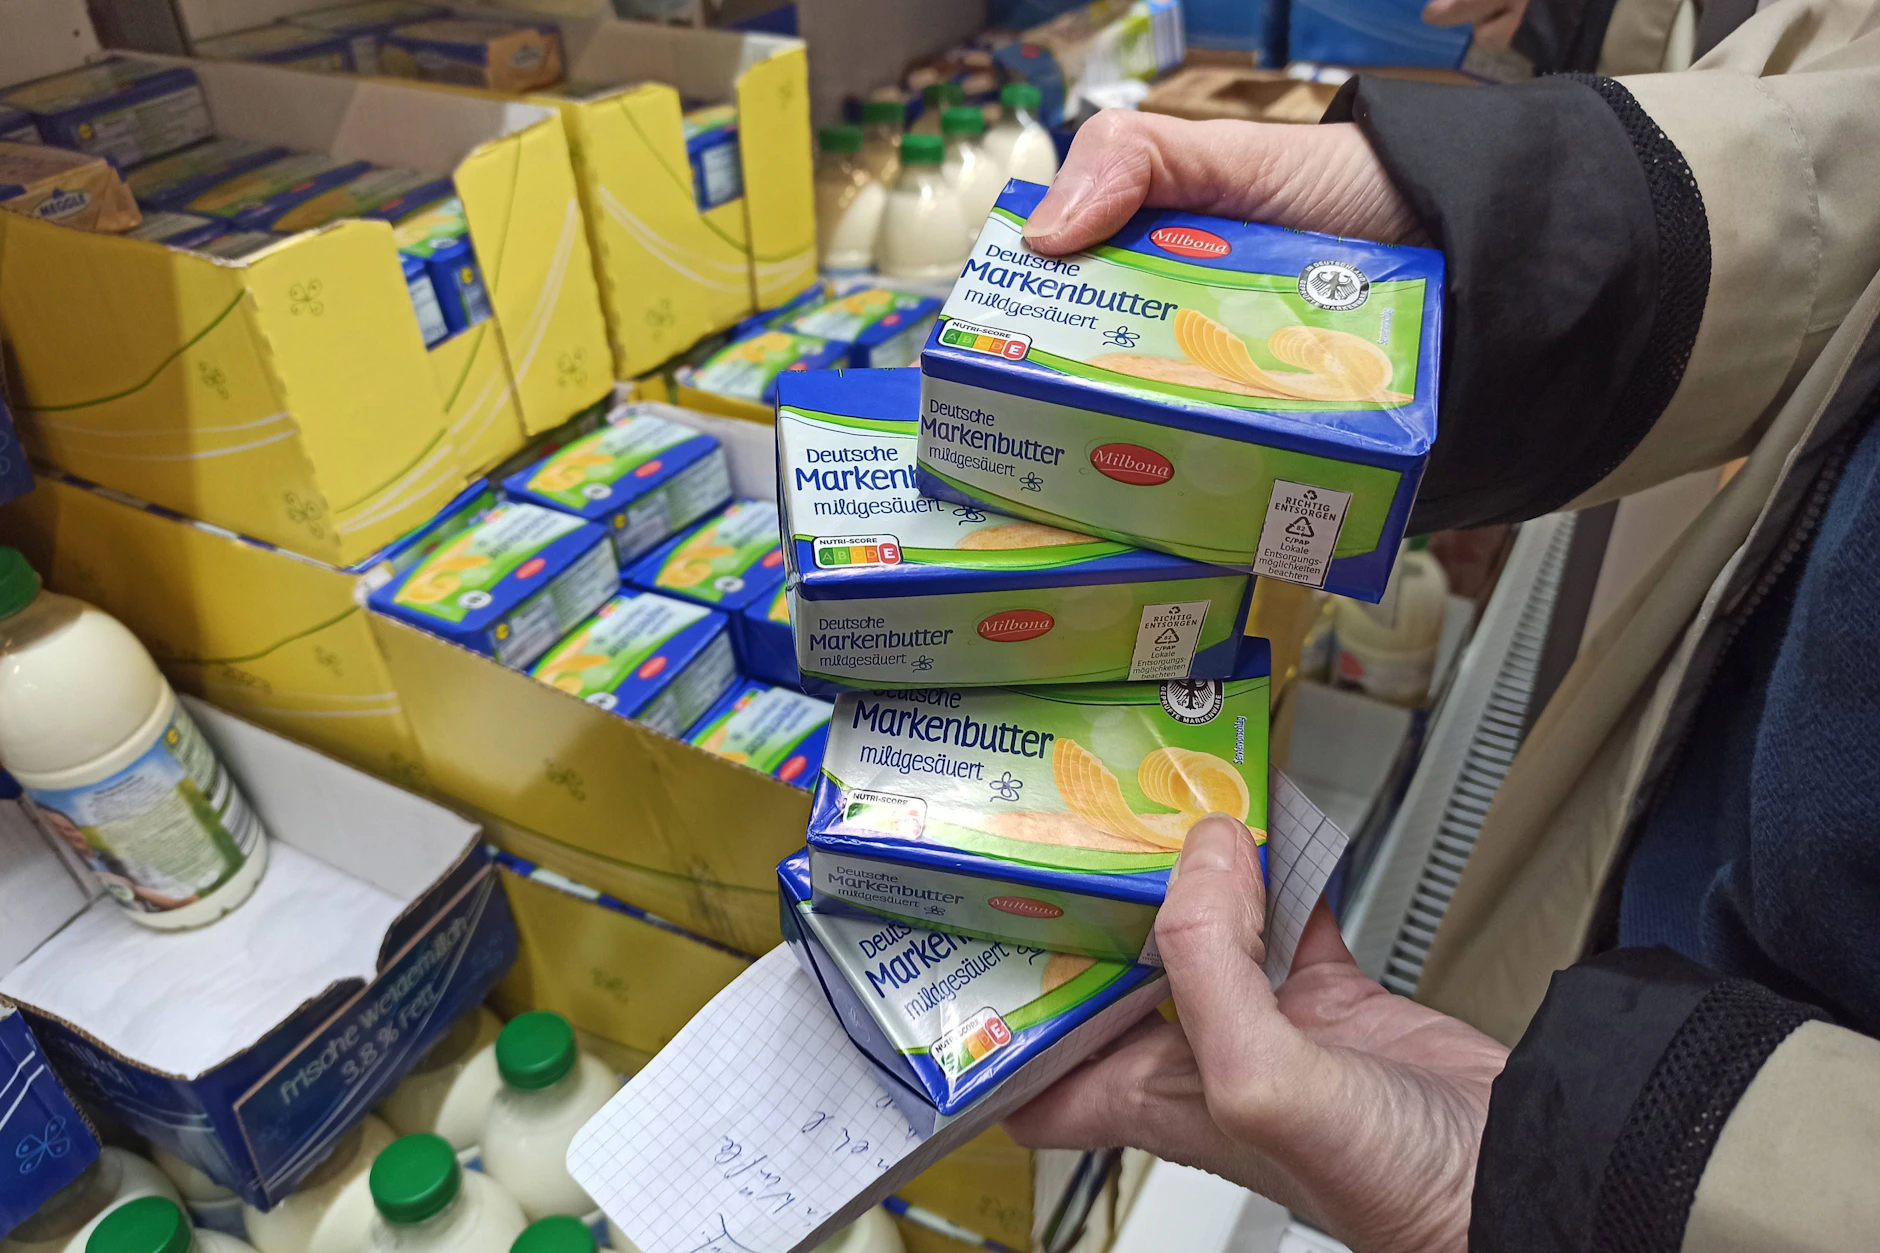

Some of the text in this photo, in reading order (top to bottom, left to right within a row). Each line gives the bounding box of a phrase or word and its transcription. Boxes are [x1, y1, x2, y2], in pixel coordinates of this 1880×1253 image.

[1150, 229, 1228, 254] Milbona
[985, 244, 1081, 277] Deutsche
[959, 258, 1179, 322] Markenbutter
[963, 288, 1100, 330] mildgesäuert
[951, 320, 1012, 339] NUTRI-SCORE
[1007, 343, 1023, 357] E
[929, 399, 996, 427] Deutsche
[920, 414, 1066, 467] Markenbutter
[806, 445, 899, 464] Deutsche
[928, 444, 1016, 478] mildgesäuert
[1092, 449, 1170, 478] Milbona
[813, 497, 945, 519] mildgesäuert
[1274, 502, 1337, 522] ENTSORGEN
[1285, 496, 1331, 512] RICHTIG
[819, 537, 878, 546] NUTRI-SCORE
[1280, 542, 1309, 555] Lokale
[1284, 536, 1310, 546] C/PAP
[883, 547, 896, 560] E
[1263, 548, 1322, 567] Entsorgungs-
[1258, 557, 1321, 575] möglichkeiten
[1267, 566, 1309, 581] beachten
[819, 615, 885, 632] Deutsche
[979, 618, 1051, 634] Milbona
[1144, 619, 1198, 629] ENTSORGEN
[1153, 613, 1193, 622] RICHTIG
[809, 628, 954, 652] Markenbutter
[819, 653, 908, 669] mildgesäuert
[1137, 656, 1187, 668] Entsorgungs-
[1150, 650, 1176, 659] Lokale
[1132, 663, 1186, 675] möglichkeiten
[1140, 671, 1176, 680] beachten
[1182, 694, 1222, 724] MARKENWARE
[852, 699, 1056, 759] Markenbutter
[859, 744, 985, 782] mildgesäuert
[853, 792, 909, 806] NUTRI-SCORE
[836, 865, 899, 884] Deutsche
[827, 872, 965, 906] Markenbutter
[837, 887, 920, 909] mildgesäuert
[992, 897, 1061, 918] Milbona
[858, 922, 913, 959] Deuts
[903, 940, 1010, 1021] mildgesäuert
[989, 1022, 1006, 1041] E
[279, 1023, 361, 1106] frische
